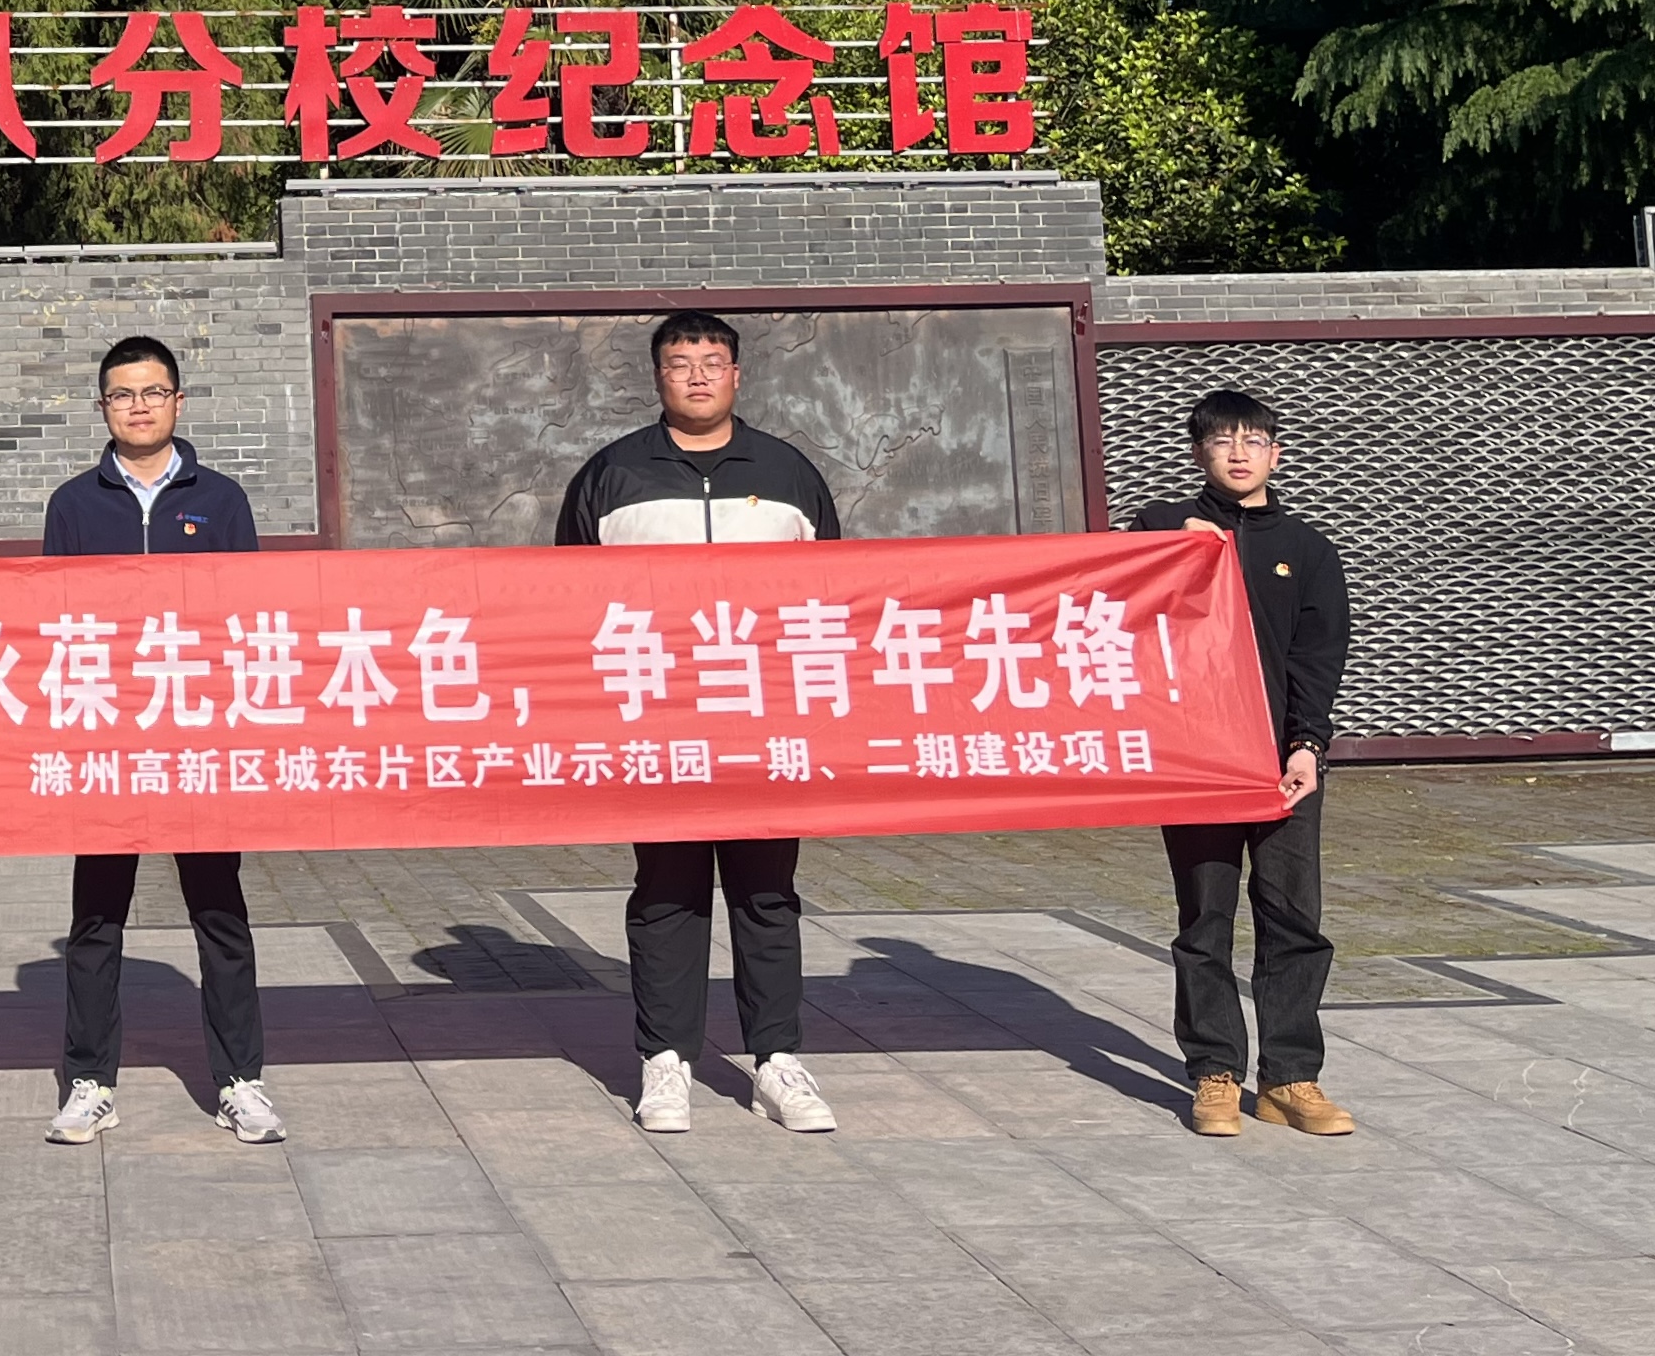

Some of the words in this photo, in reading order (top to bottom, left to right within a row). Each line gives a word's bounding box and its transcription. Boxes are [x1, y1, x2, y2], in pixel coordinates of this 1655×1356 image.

[1022, 354, 1054, 533] 中国人民抗日军
[28, 729, 1155, 797] 滁州高新区城东片区产业示范园一期、二期建设项目
